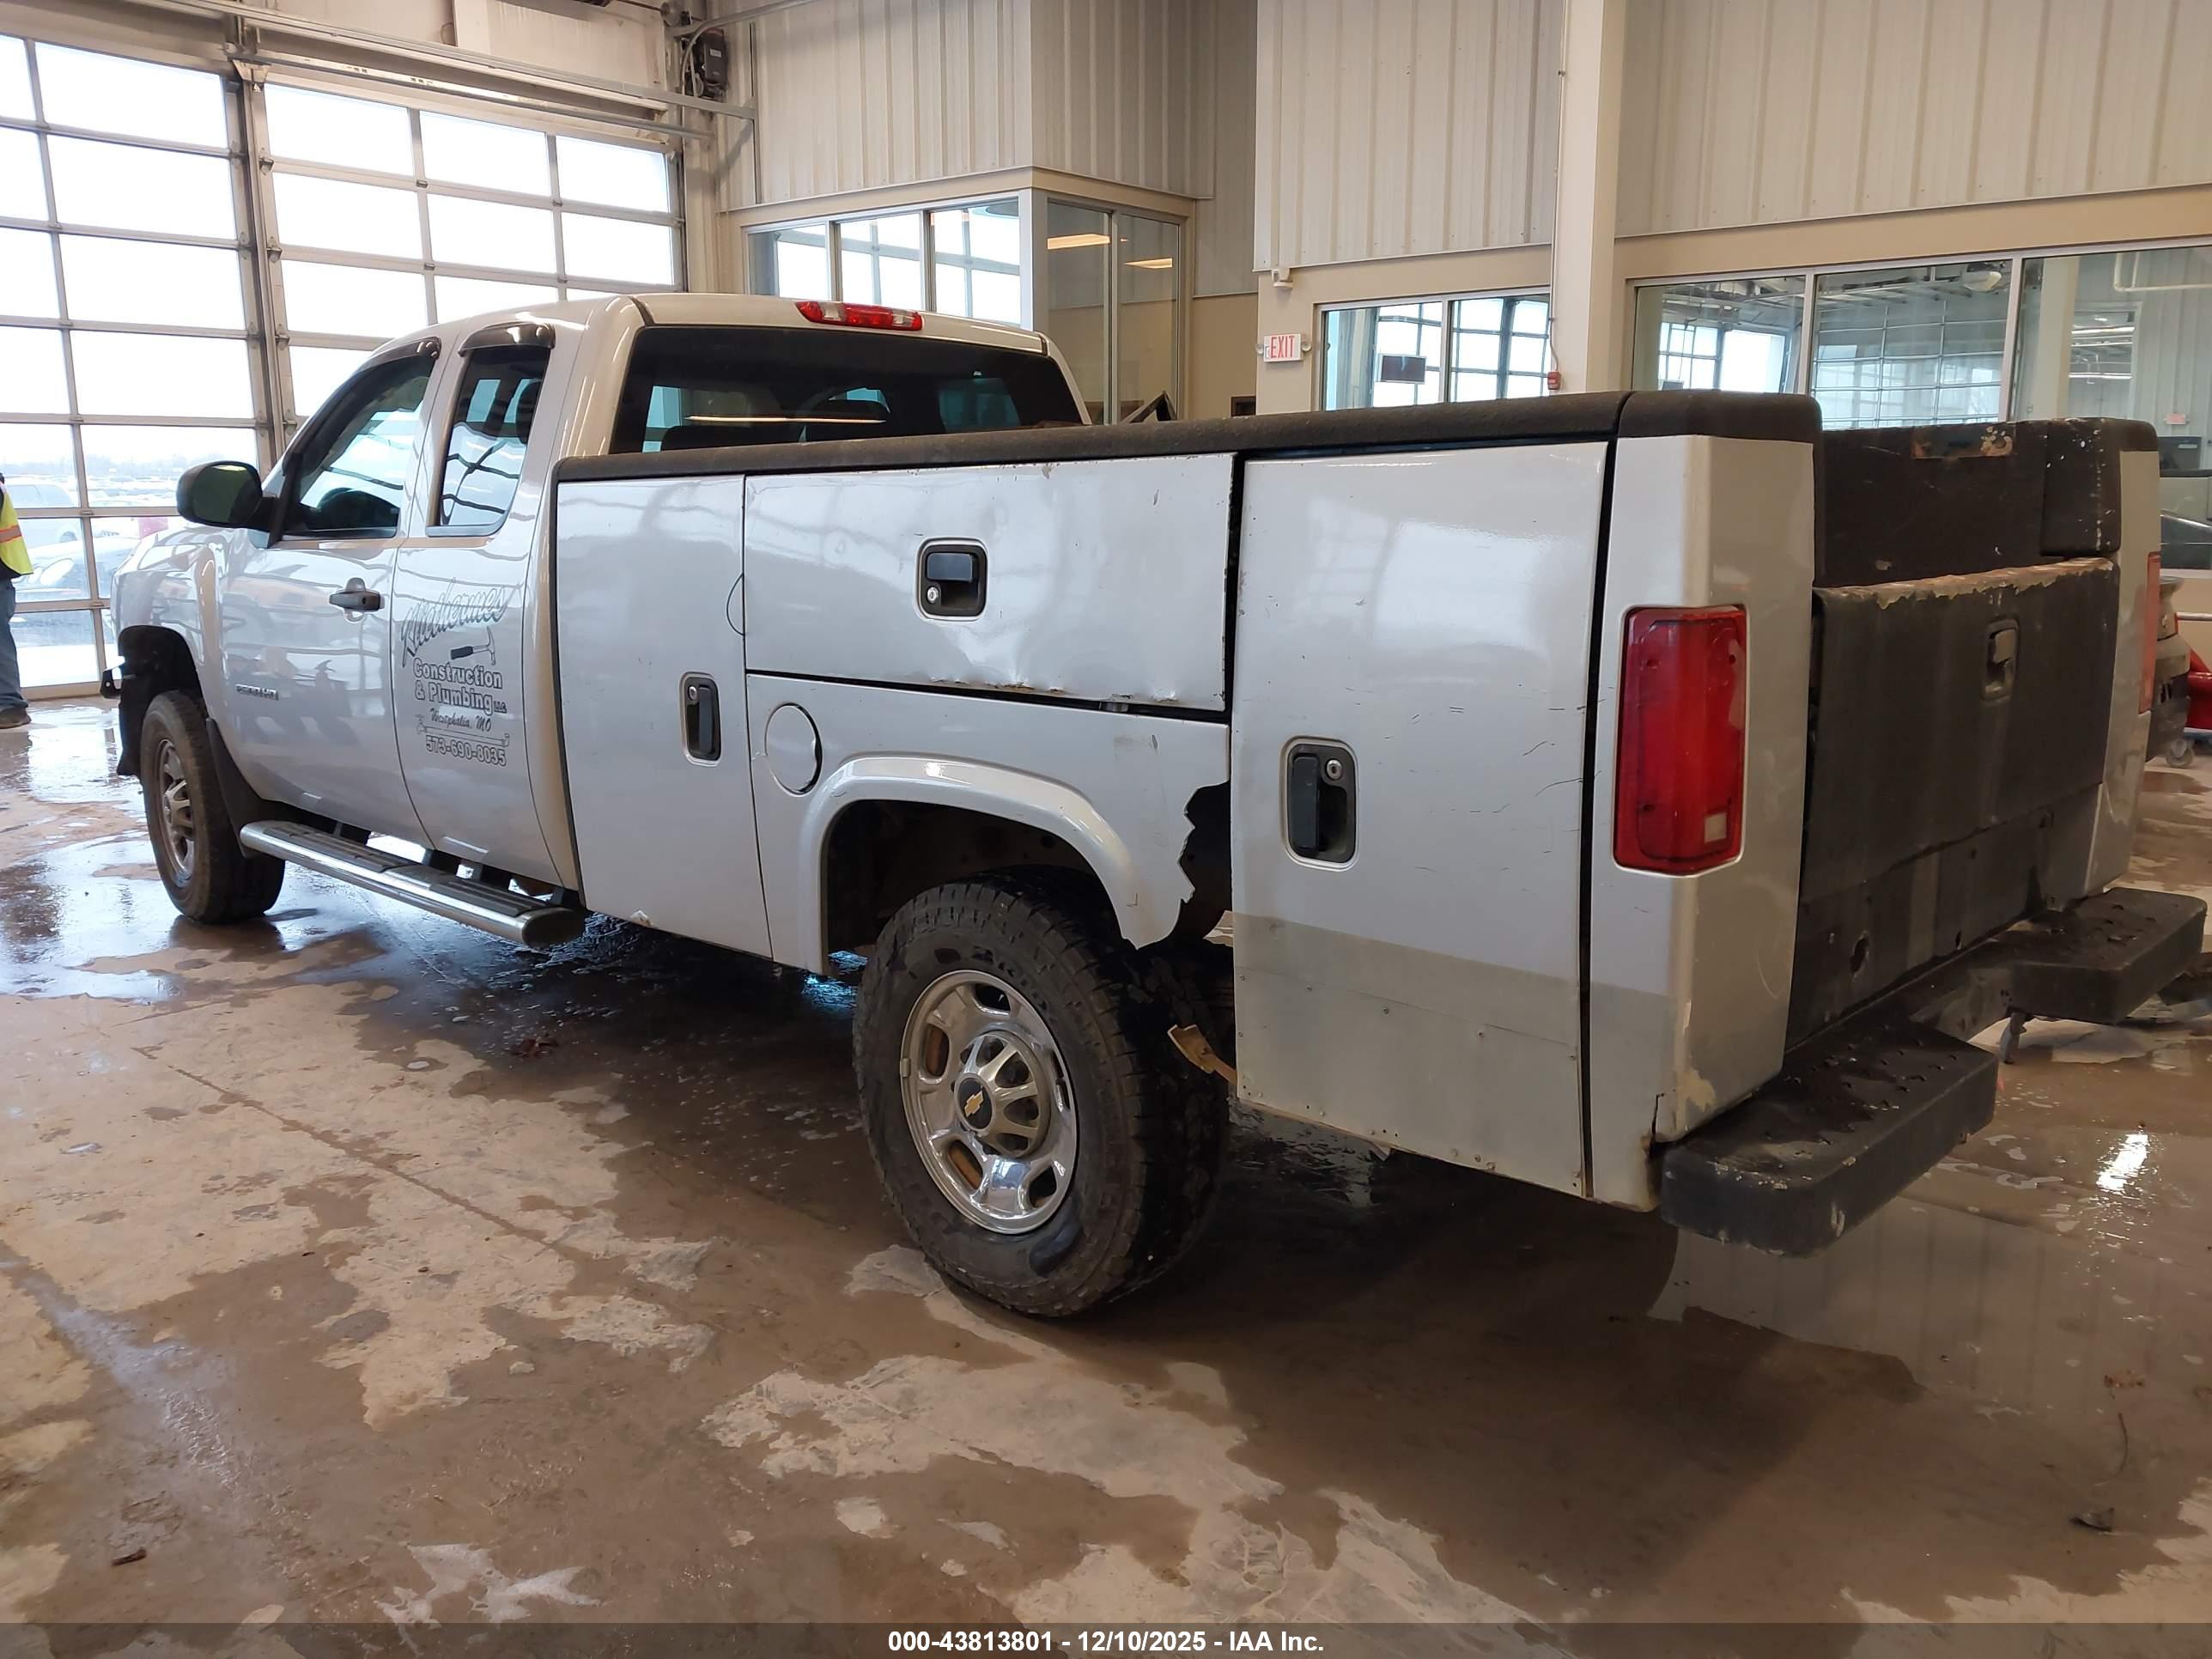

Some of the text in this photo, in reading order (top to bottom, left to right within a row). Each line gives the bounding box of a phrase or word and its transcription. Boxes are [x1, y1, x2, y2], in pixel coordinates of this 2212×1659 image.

[1271, 336, 1295, 358] EXIT
[413, 658, 503, 689] Construction
[415, 680, 425, 701] &
[428, 682, 494, 715] Plumbing
[476, 716, 492, 732] MO
[426, 735, 507, 767] 573-690-8035
